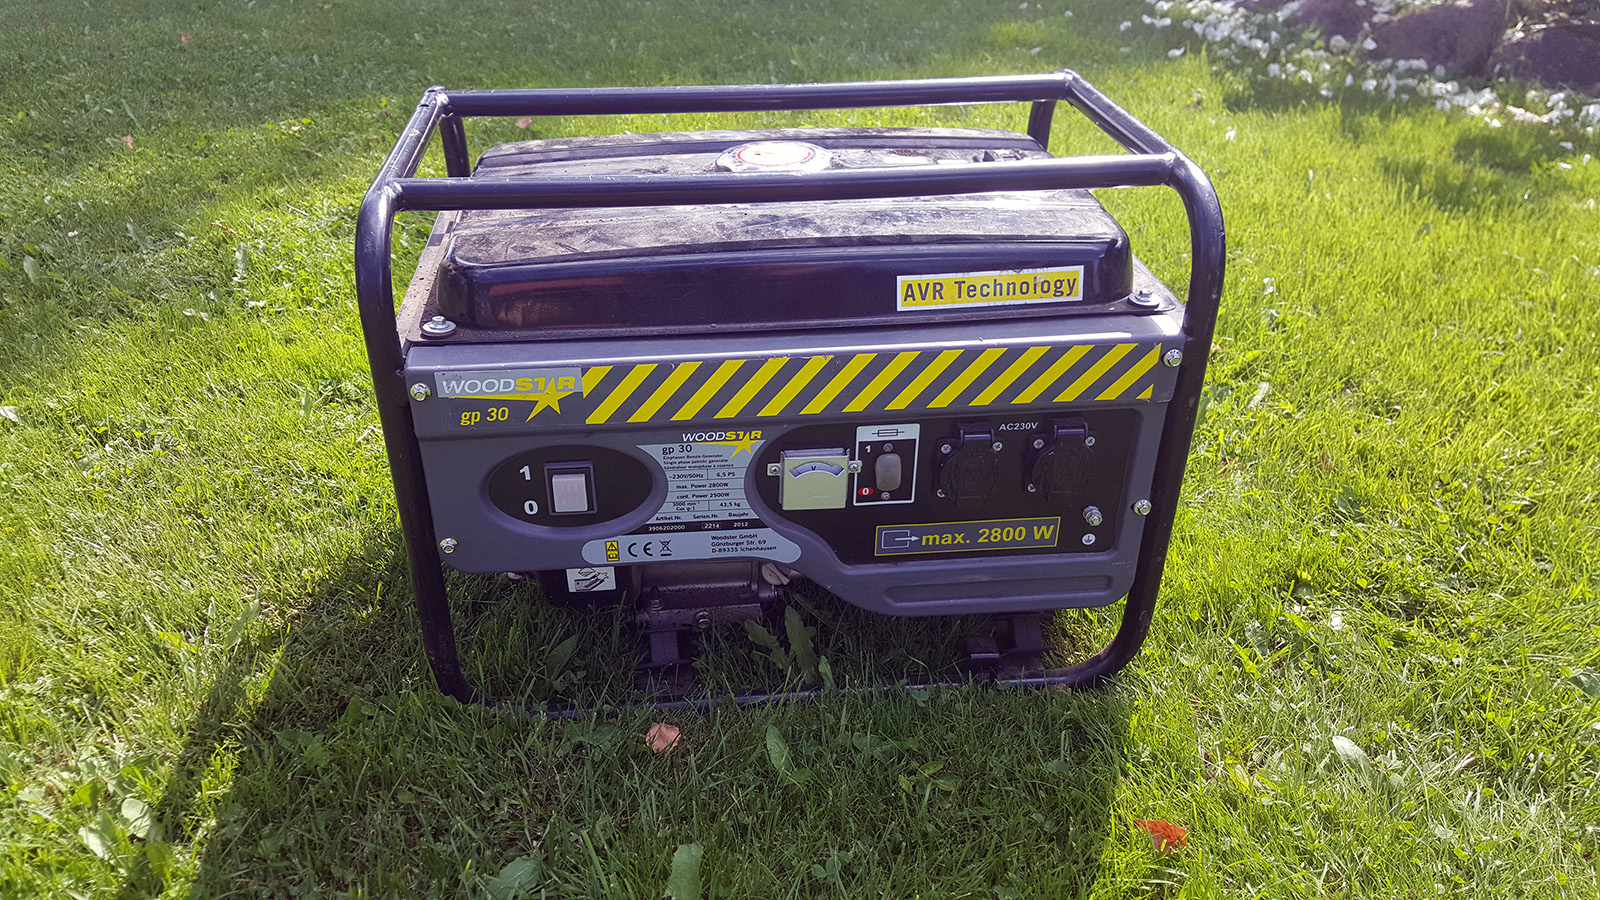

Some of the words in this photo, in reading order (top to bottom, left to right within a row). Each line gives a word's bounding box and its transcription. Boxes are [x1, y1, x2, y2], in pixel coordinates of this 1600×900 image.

[903, 281, 944, 302] AVR
[954, 276, 1077, 298] Technology
[442, 376, 576, 394] WOODSTAR
[460, 410, 481, 426] gp
[486, 407, 509, 422] 30
[998, 421, 1039, 431] AC230V
[682, 430, 762, 442] WOODSTAR
[662, 446, 675, 456] gp
[678, 444, 693, 453] 30
[519, 465, 531, 481] 1
[523, 500, 539, 515] 0
[648, 524, 686, 532] 3906202000
[921, 532, 971, 546] max.
[977, 526, 1026, 543] 2800
[1033, 525, 1055, 540] W
